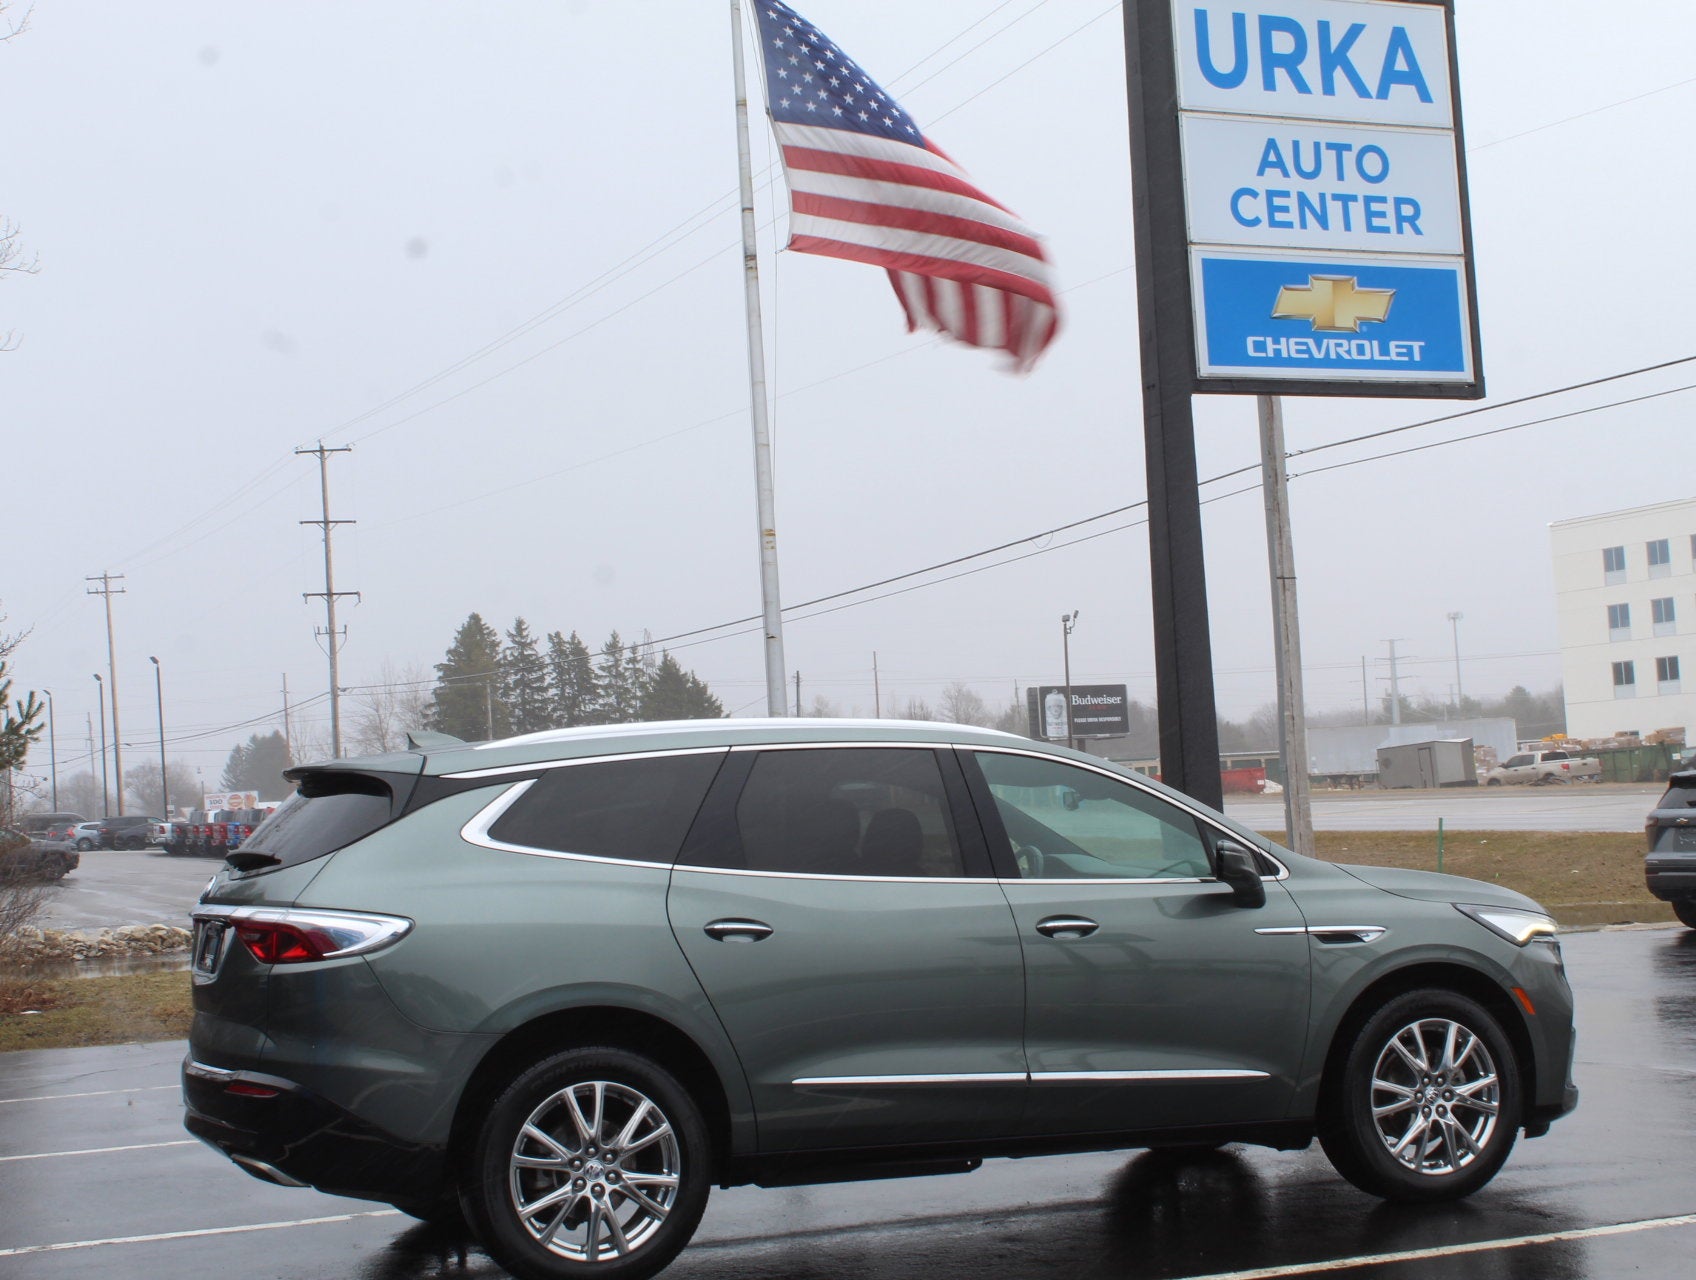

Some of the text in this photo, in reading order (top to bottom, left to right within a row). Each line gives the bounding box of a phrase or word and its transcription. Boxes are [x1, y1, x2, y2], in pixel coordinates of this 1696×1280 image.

[1193, 8, 1434, 104] URKA
[1256, 137, 1390, 184] AUTO
[1229, 187, 1424, 236] CENTER
[1246, 336, 1425, 361] CHEVROLET
[1071, 694, 1122, 705] Budweiser
